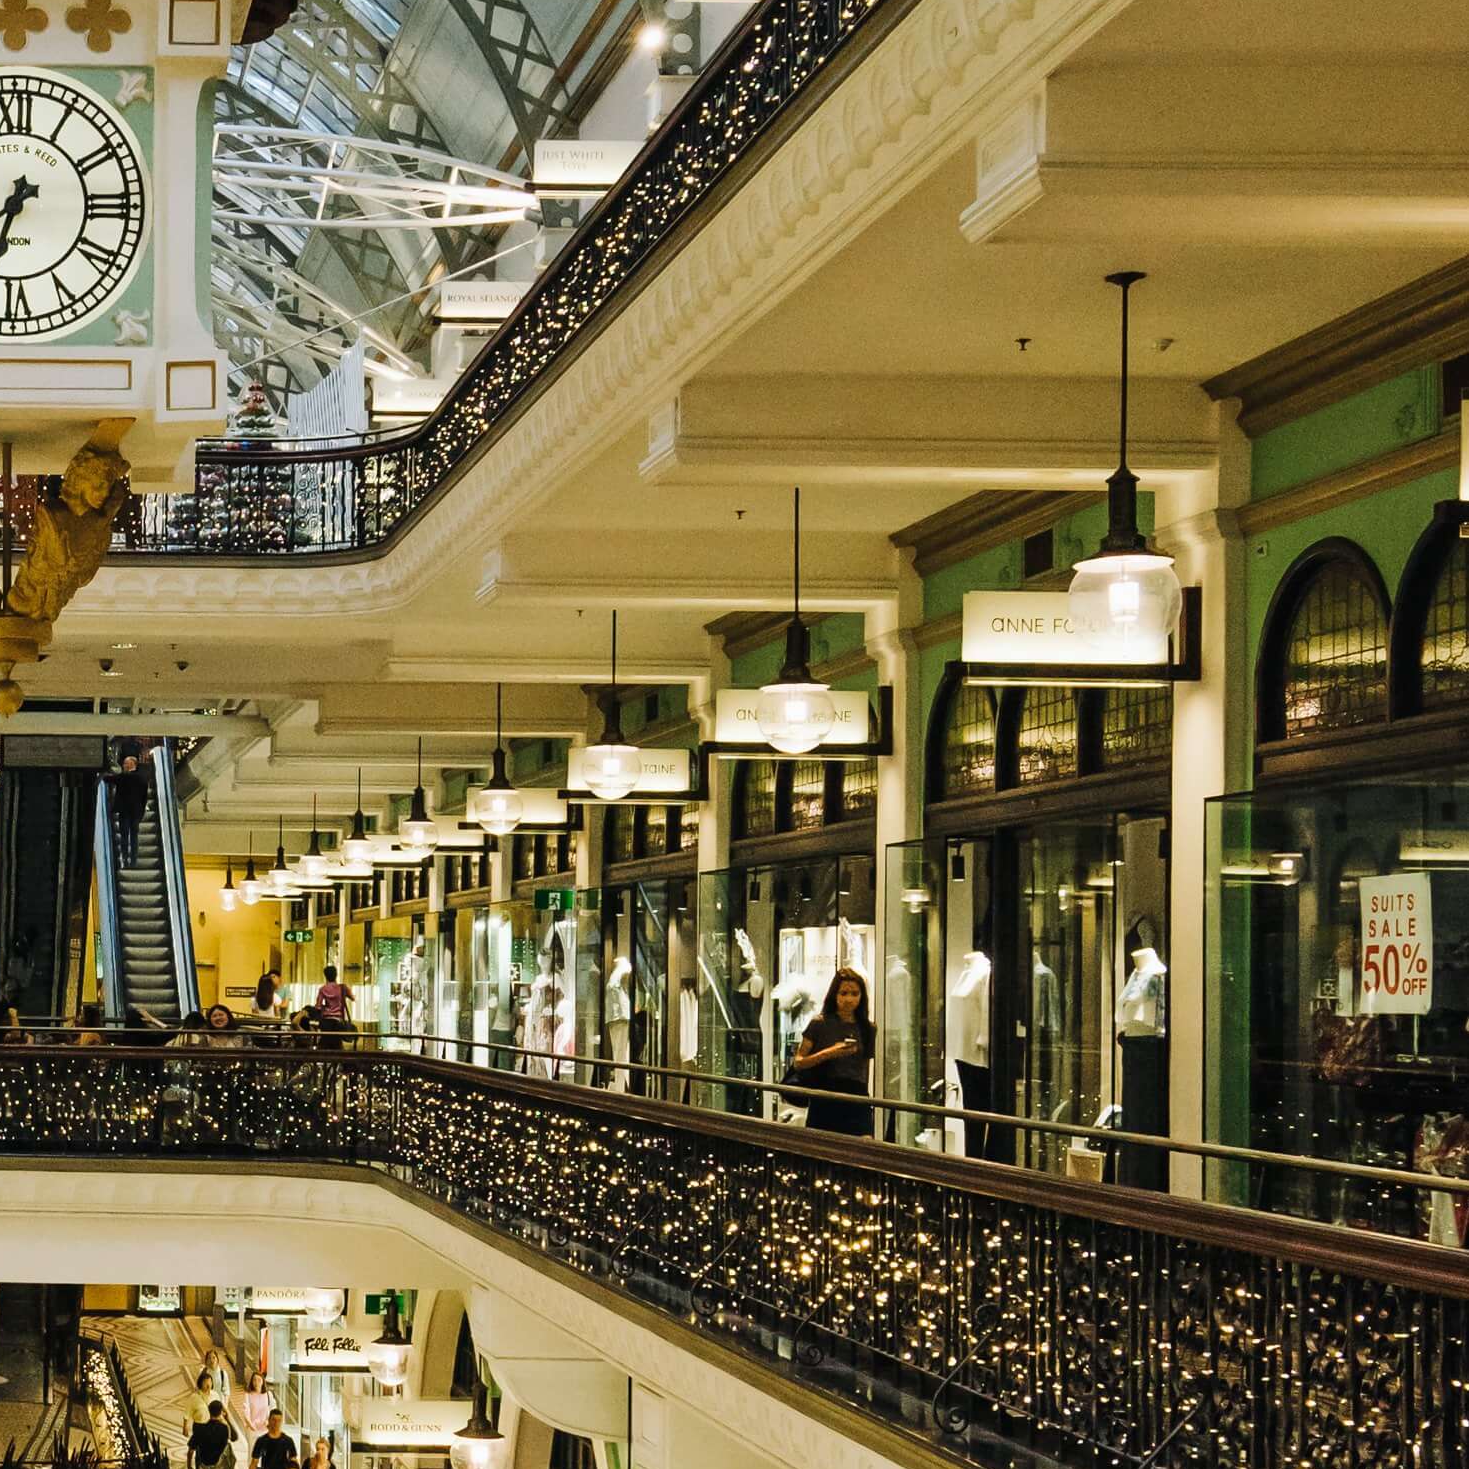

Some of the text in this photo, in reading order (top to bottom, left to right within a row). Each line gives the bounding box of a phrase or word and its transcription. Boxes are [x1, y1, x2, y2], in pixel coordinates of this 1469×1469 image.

[23, 145, 30, 154] &
[34, 148, 58, 168] REED
[6, 237, 31, 246] NDON
[480, 294, 523, 303] SELANGO
[1371, 893, 1415, 913] SUITS
[1369, 917, 1416, 938] SALE
[1363, 942, 1428, 995] 50%
[1402, 978, 1427, 995] OFF
[305, 1337, 362, 1356] Folli Follie
